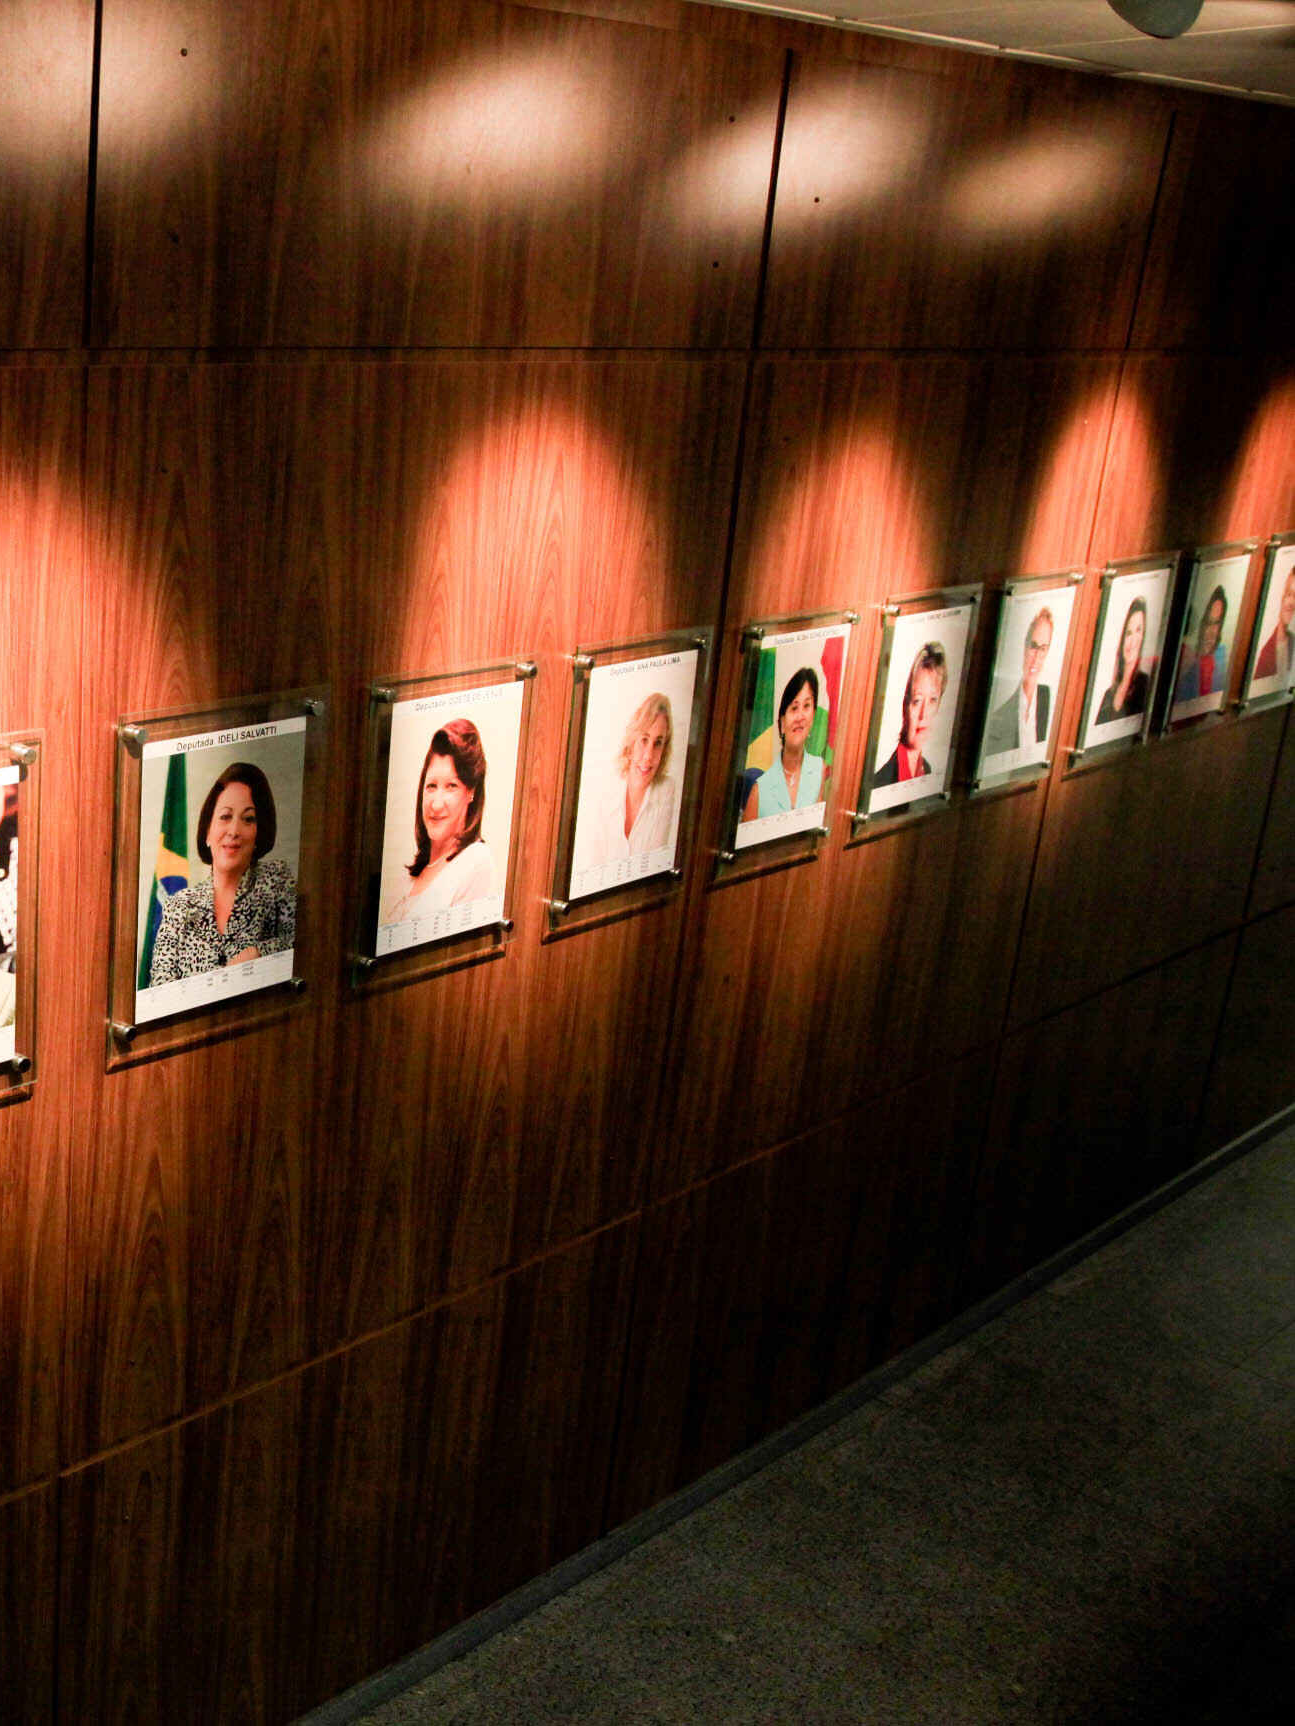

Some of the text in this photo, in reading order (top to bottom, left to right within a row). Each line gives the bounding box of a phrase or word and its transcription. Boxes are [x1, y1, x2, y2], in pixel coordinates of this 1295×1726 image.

[176, 726, 277, 752] Deputada IDELI SALVATTI
